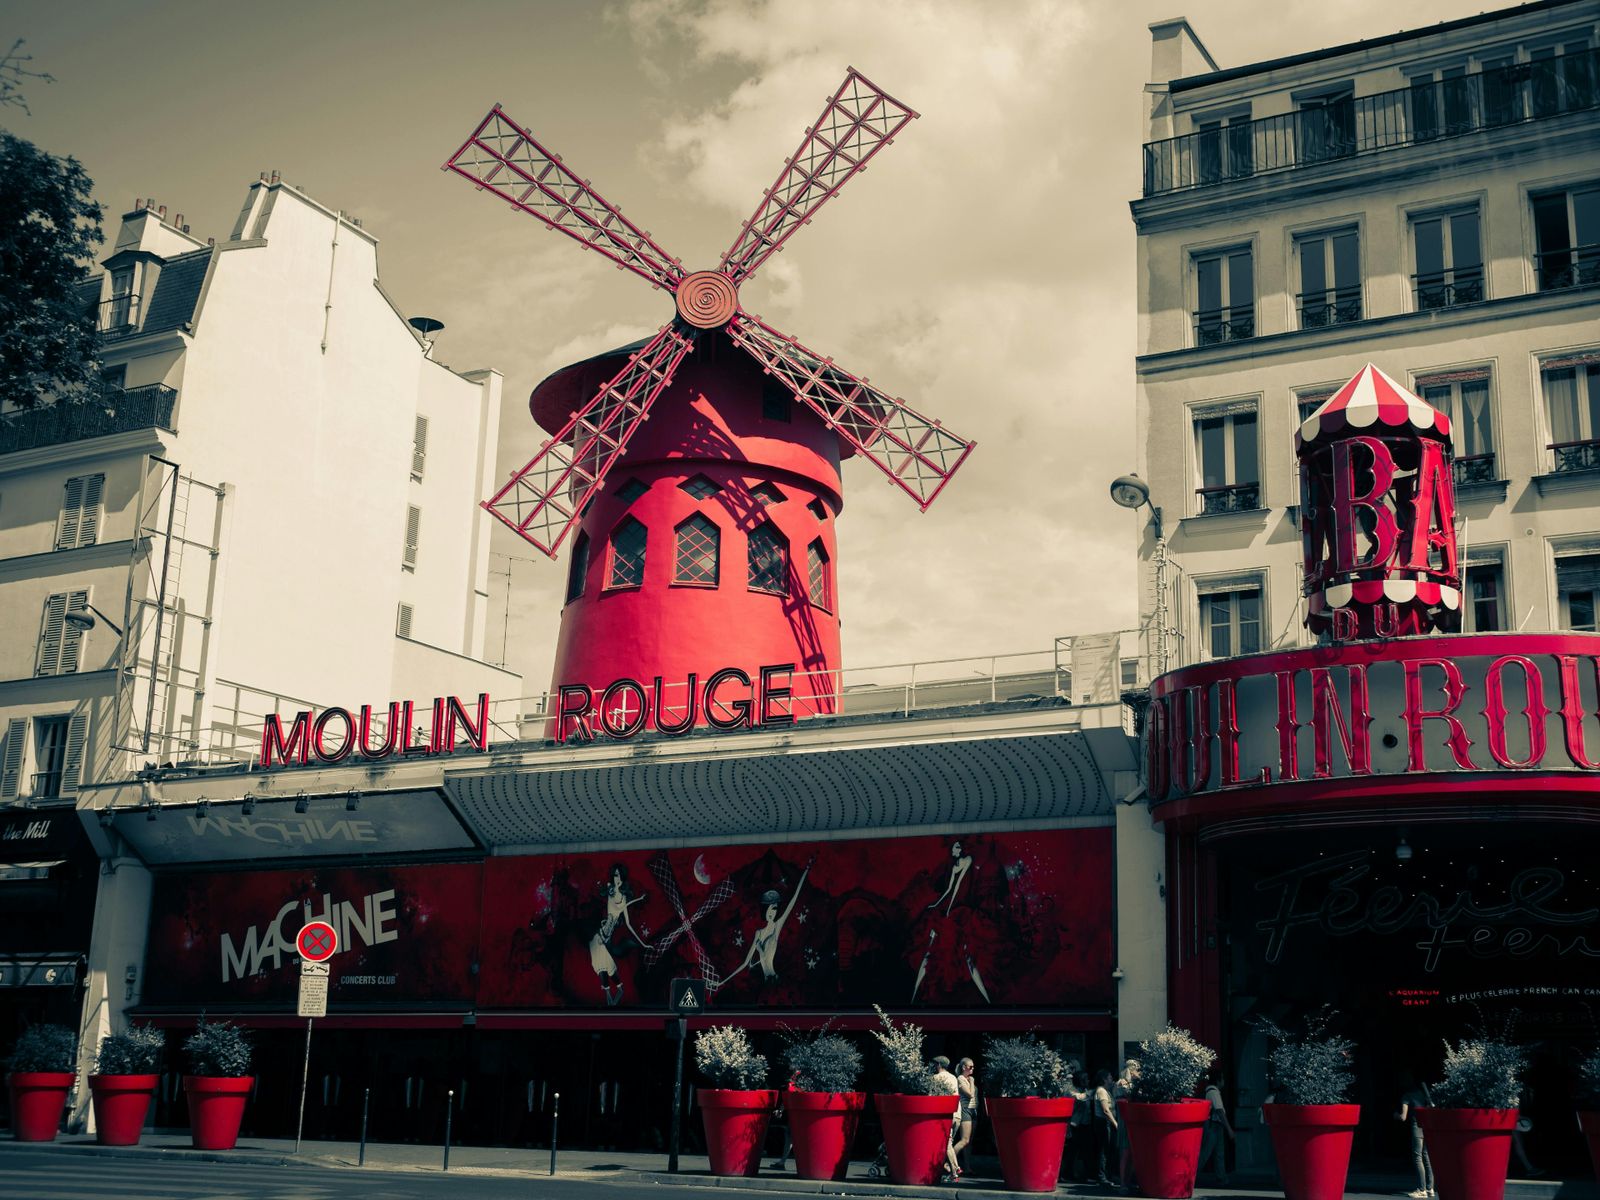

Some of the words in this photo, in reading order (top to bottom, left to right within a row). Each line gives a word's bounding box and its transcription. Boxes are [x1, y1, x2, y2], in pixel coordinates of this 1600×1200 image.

[260, 692, 490, 768] MOULIN
[555, 662, 796, 744] ROUGE
[22, 820, 51, 838] Mill
[220, 888, 399, 983] MACHINE
[340, 975, 377, 986] CONCERTS
[377, 975, 396, 985] CLUB
[1459, 991, 1481, 1002] PLUS
[1562, 987, 1580, 995] CAN
